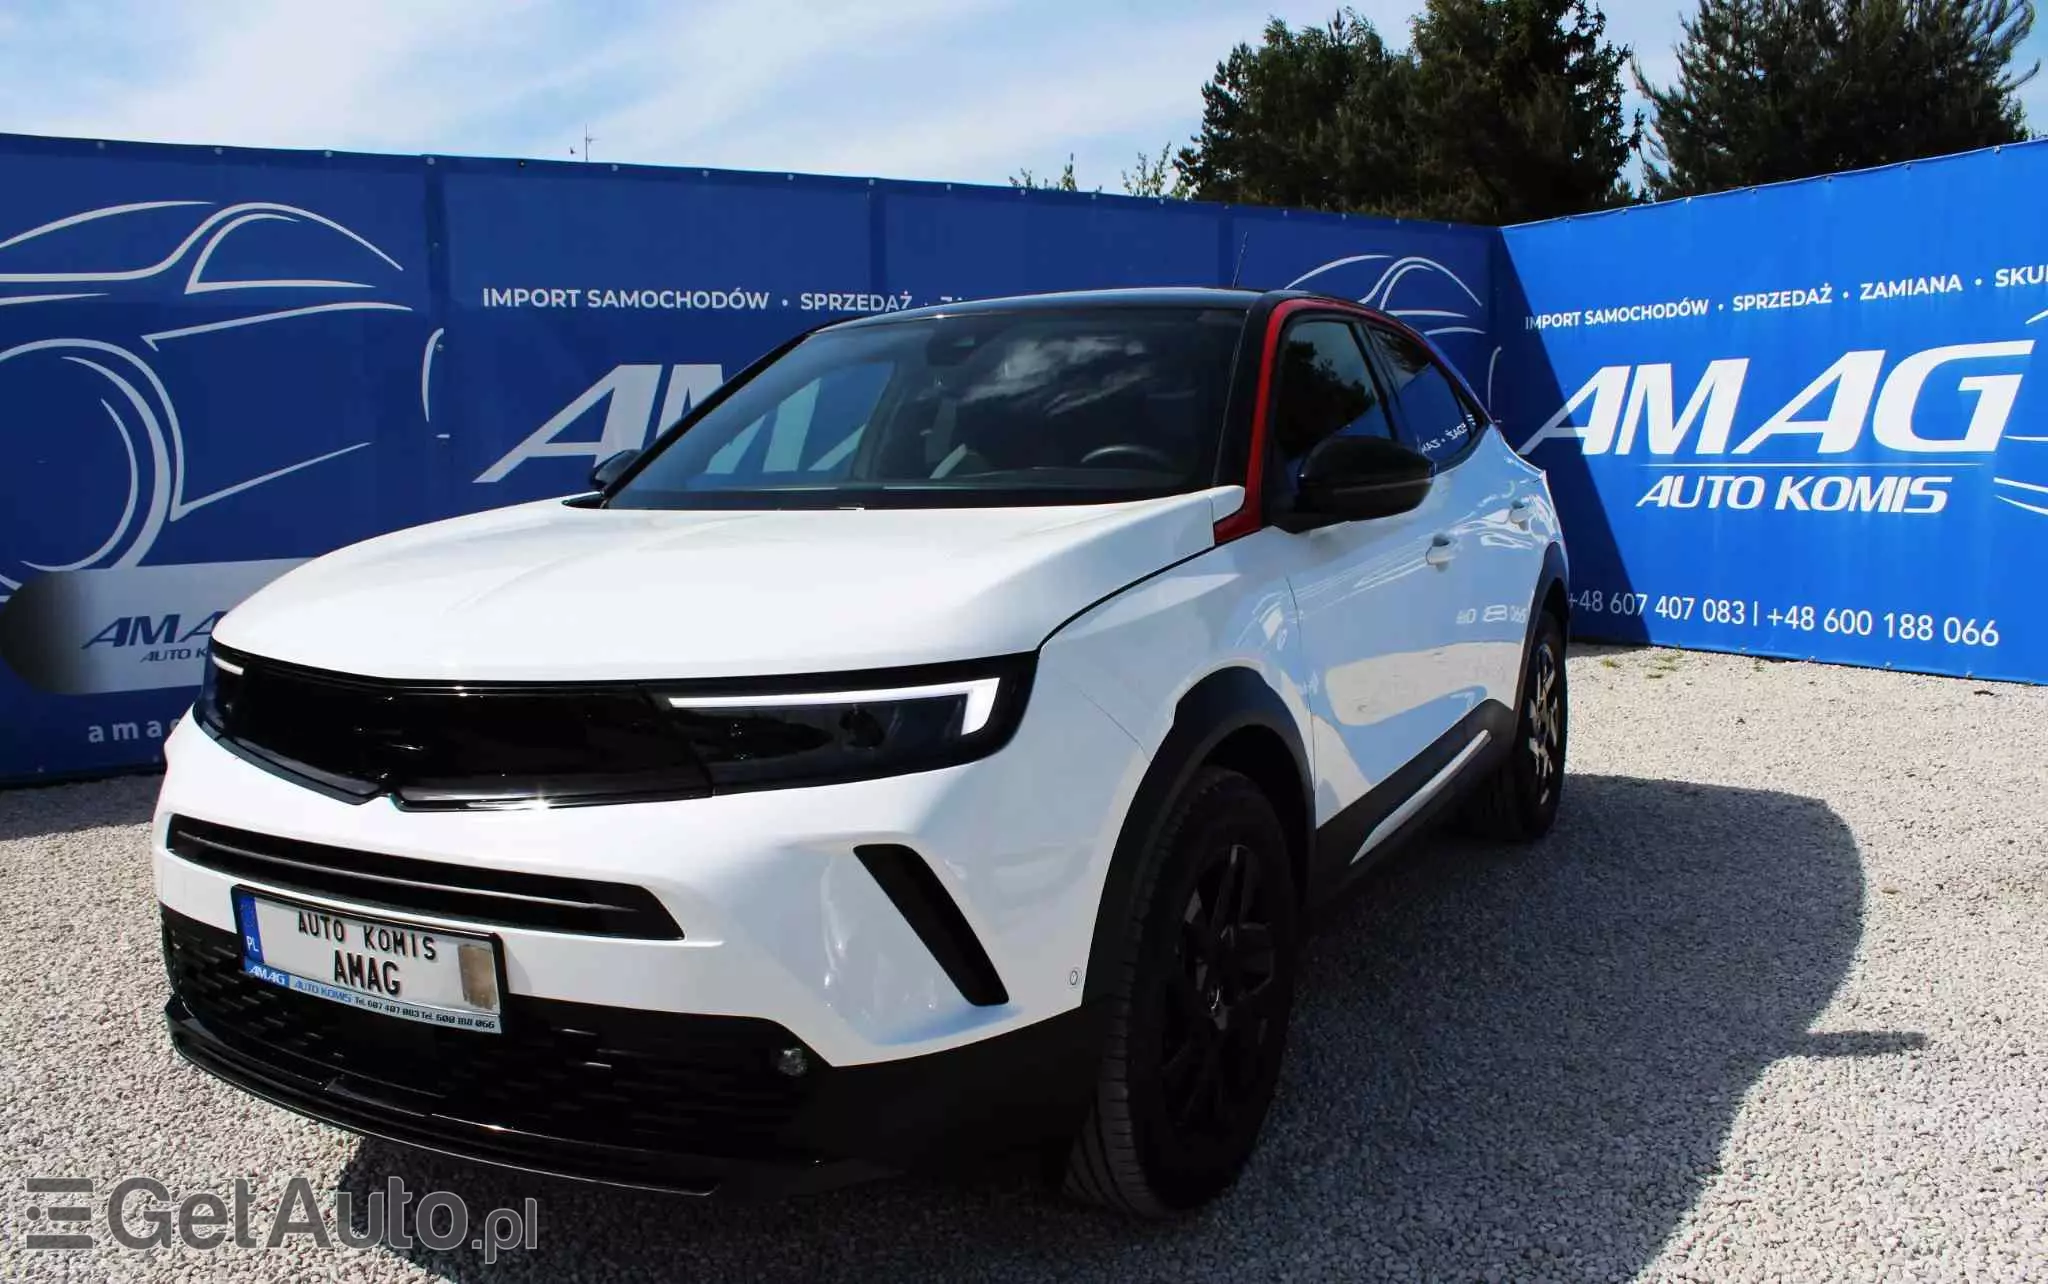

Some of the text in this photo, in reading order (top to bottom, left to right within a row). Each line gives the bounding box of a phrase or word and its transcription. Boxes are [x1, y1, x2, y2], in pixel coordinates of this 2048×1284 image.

[482, 287, 913, 312] IMPORT SAMOCHODÓW SPRZEDAŻ
[1525, 311, 1582, 330] IMPORT
[1584, 297, 1709, 325] SAMOCHODÓW
[1732, 283, 1833, 312] SPRZEDAŻ
[1860, 274, 1964, 300] ZAMIANA
[1515, 339, 2036, 455] AMAG
[1636, 475, 1953, 514] AUTO KOMIS
[1609, 592, 1649, 616] 607
[1655, 595, 1696, 620] 407
[1702, 598, 1746, 625] 083
[1767, 605, 1816, 632] +48
[1823, 608, 1873, 636] 600
[1883, 612, 1934, 641] 188
[1943, 616, 2000, 647] 066
[139, 648, 191, 663] AUTO
[246, 935, 260, 952] PL
[298, 910, 438, 961] AUTO KOMIS
[249, 965, 287, 986] AMAG
[295, 979, 320, 994] AUTO
[334, 949, 402, 996] AMAG
